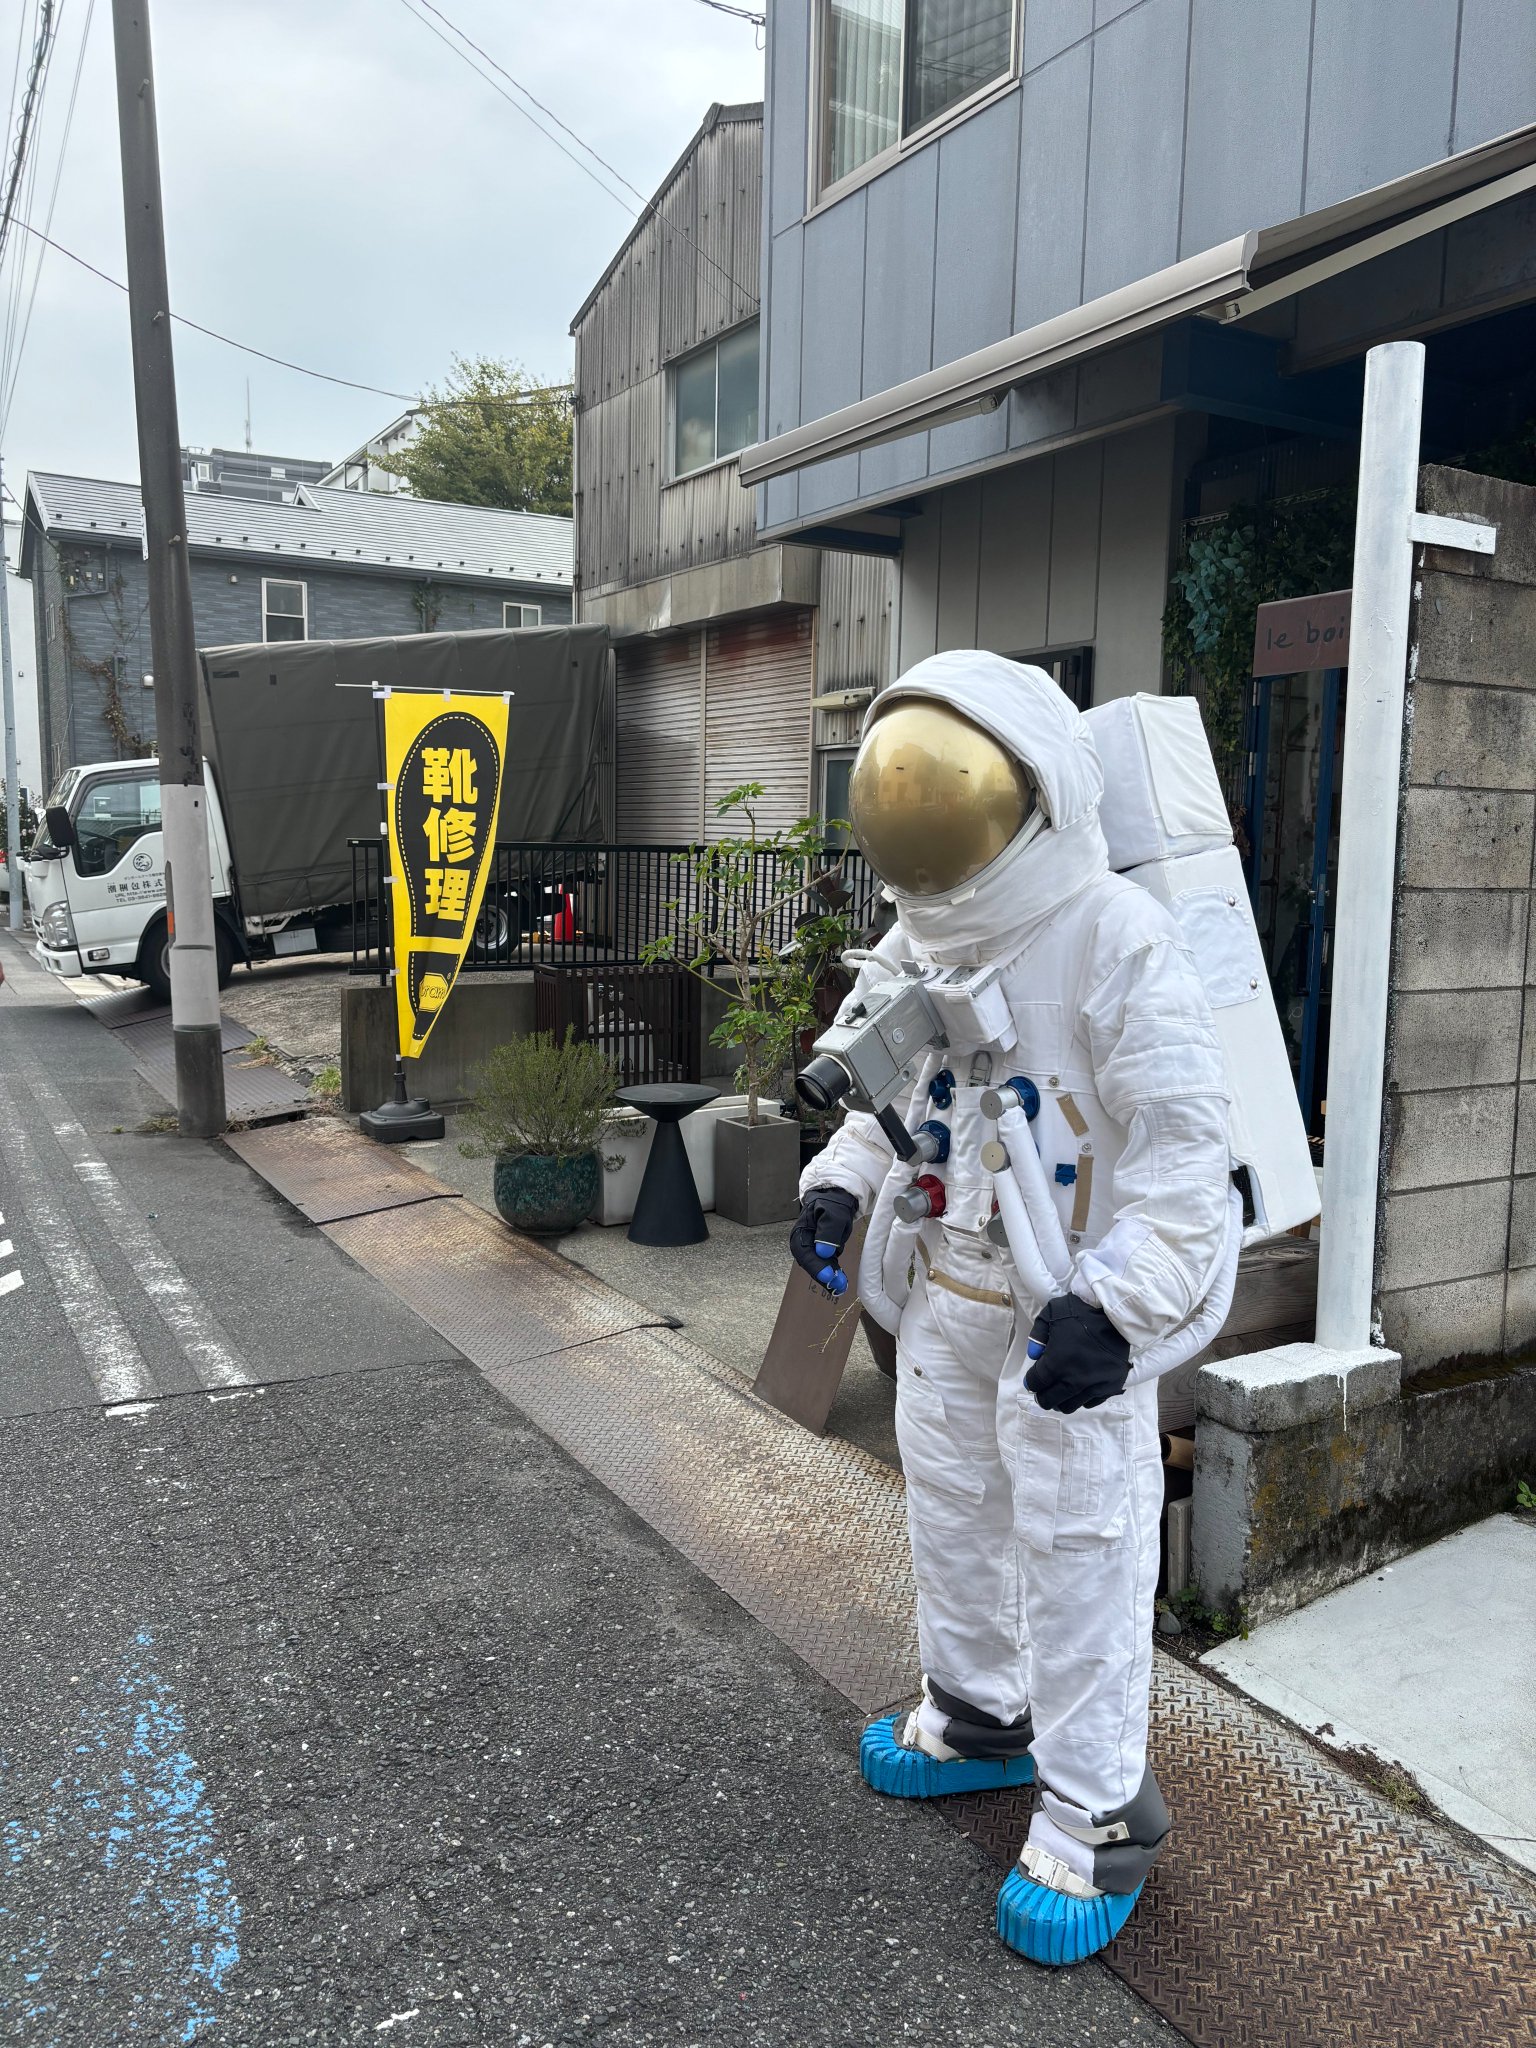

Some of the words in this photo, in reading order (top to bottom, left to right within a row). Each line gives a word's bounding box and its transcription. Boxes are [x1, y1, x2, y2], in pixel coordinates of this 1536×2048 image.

[1266, 627, 1294, 651] le
[1306, 616, 1348, 644] boi
[421, 747, 478, 922] 靴修理
[808, 1280, 817, 1294] le
